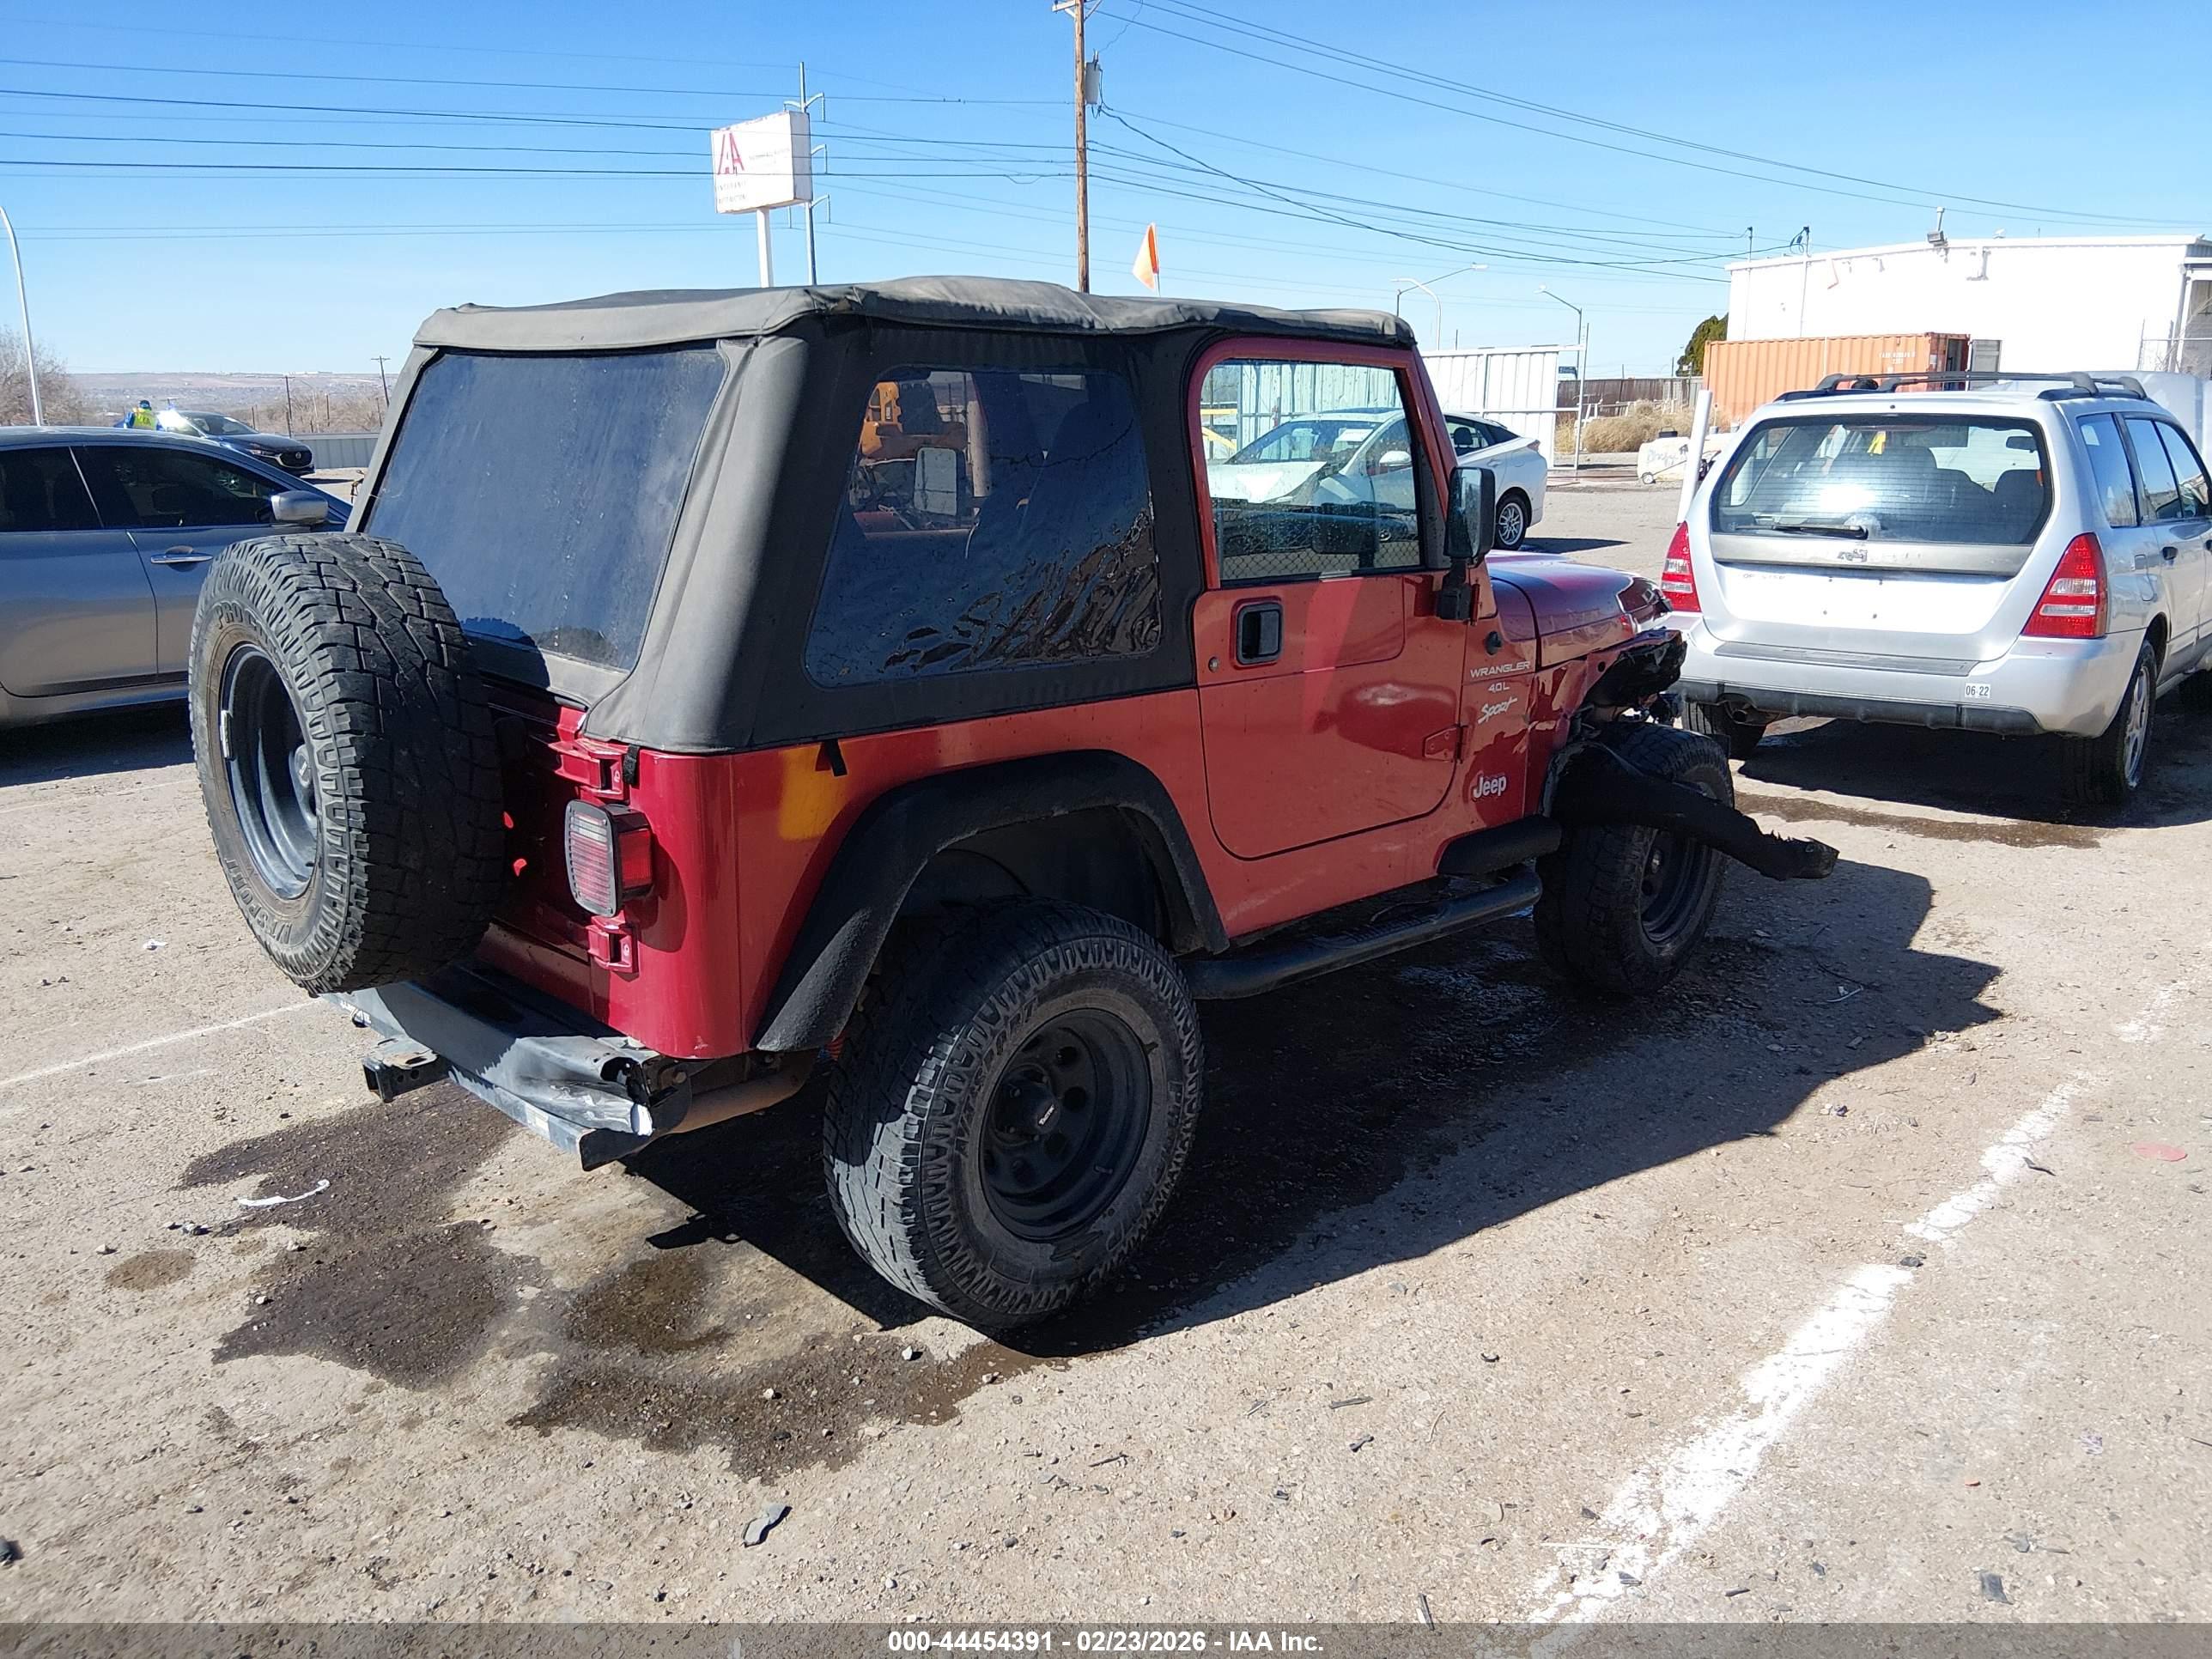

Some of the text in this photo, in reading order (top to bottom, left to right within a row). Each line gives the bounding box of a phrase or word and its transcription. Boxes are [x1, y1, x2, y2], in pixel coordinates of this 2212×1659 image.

[1469, 660, 1531, 678] WRANGLER
[1966, 685, 1990, 696] 06 22
[1474, 774, 1507, 799] Jeep
